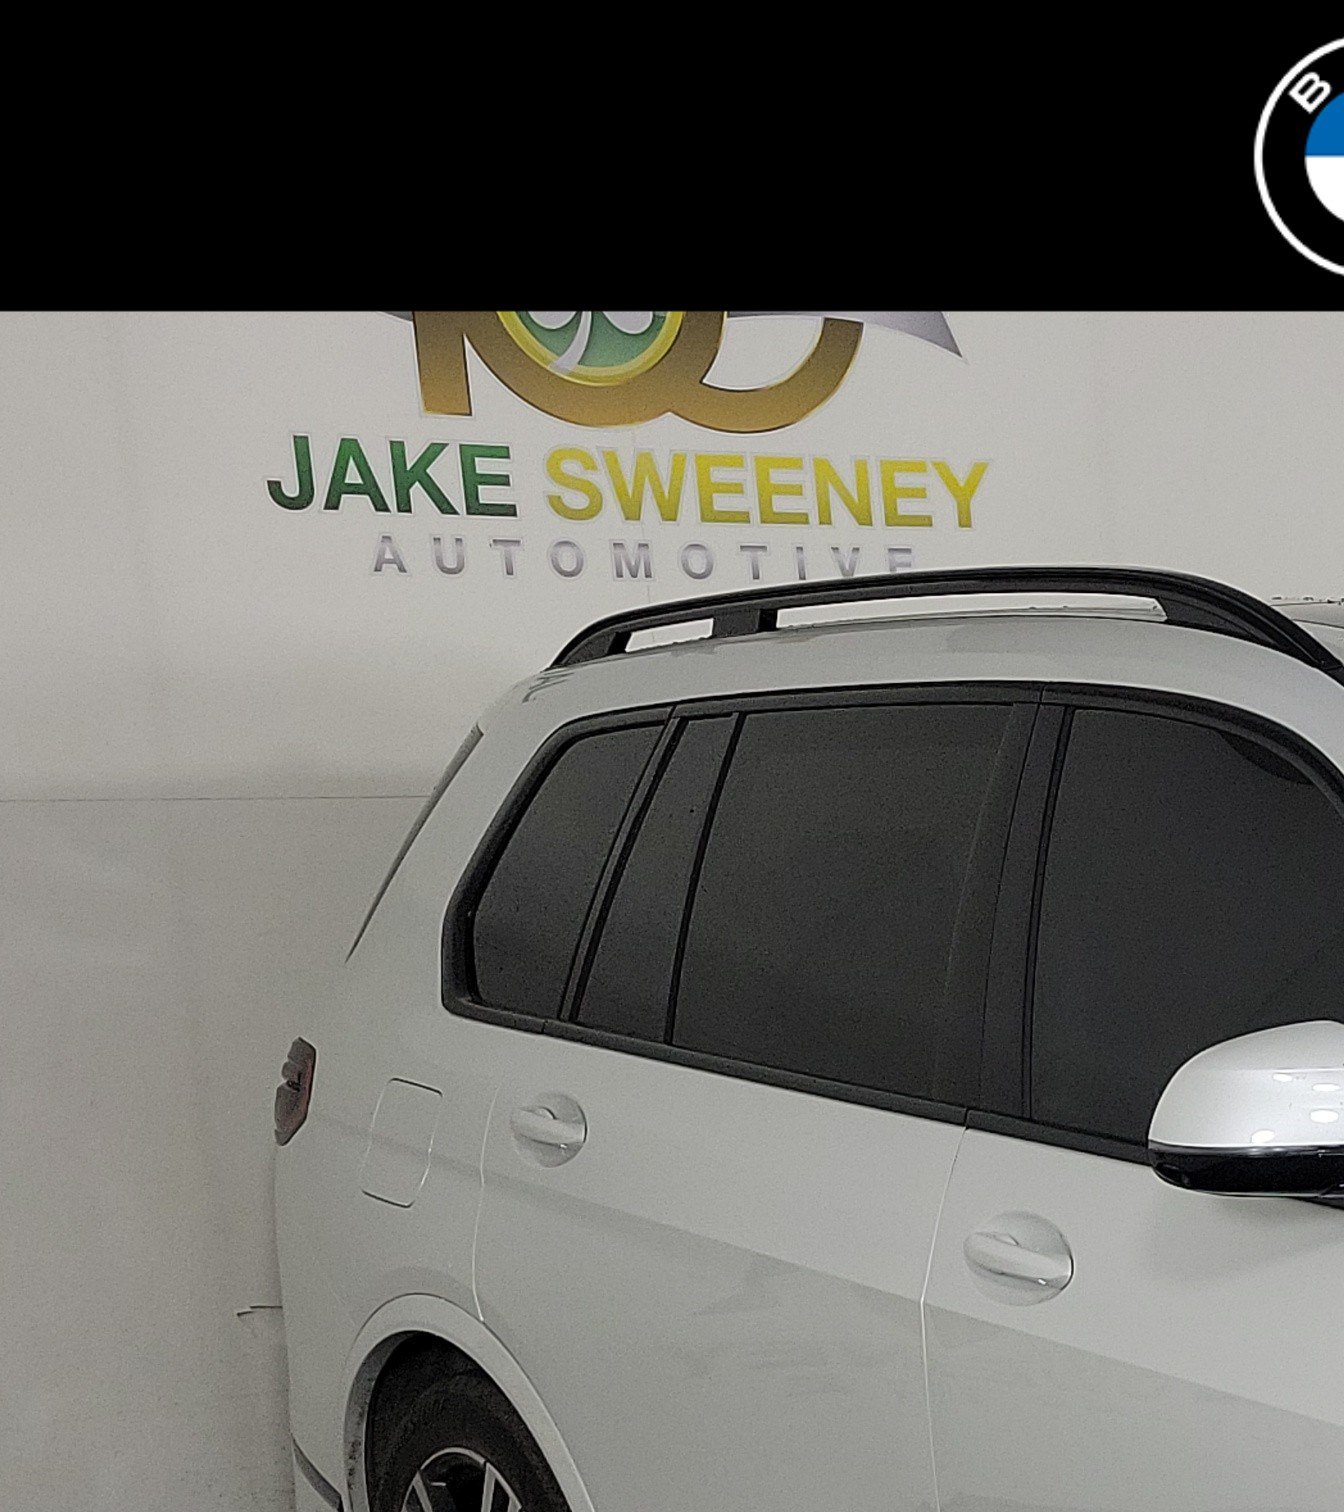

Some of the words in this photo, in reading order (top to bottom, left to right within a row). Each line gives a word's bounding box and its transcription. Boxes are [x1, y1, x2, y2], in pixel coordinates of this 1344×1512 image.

[267, 435, 518, 518] JAKE
[546, 448, 990, 529] SWEENEY
[373, 535, 913, 581] AUTOMOTIVE
